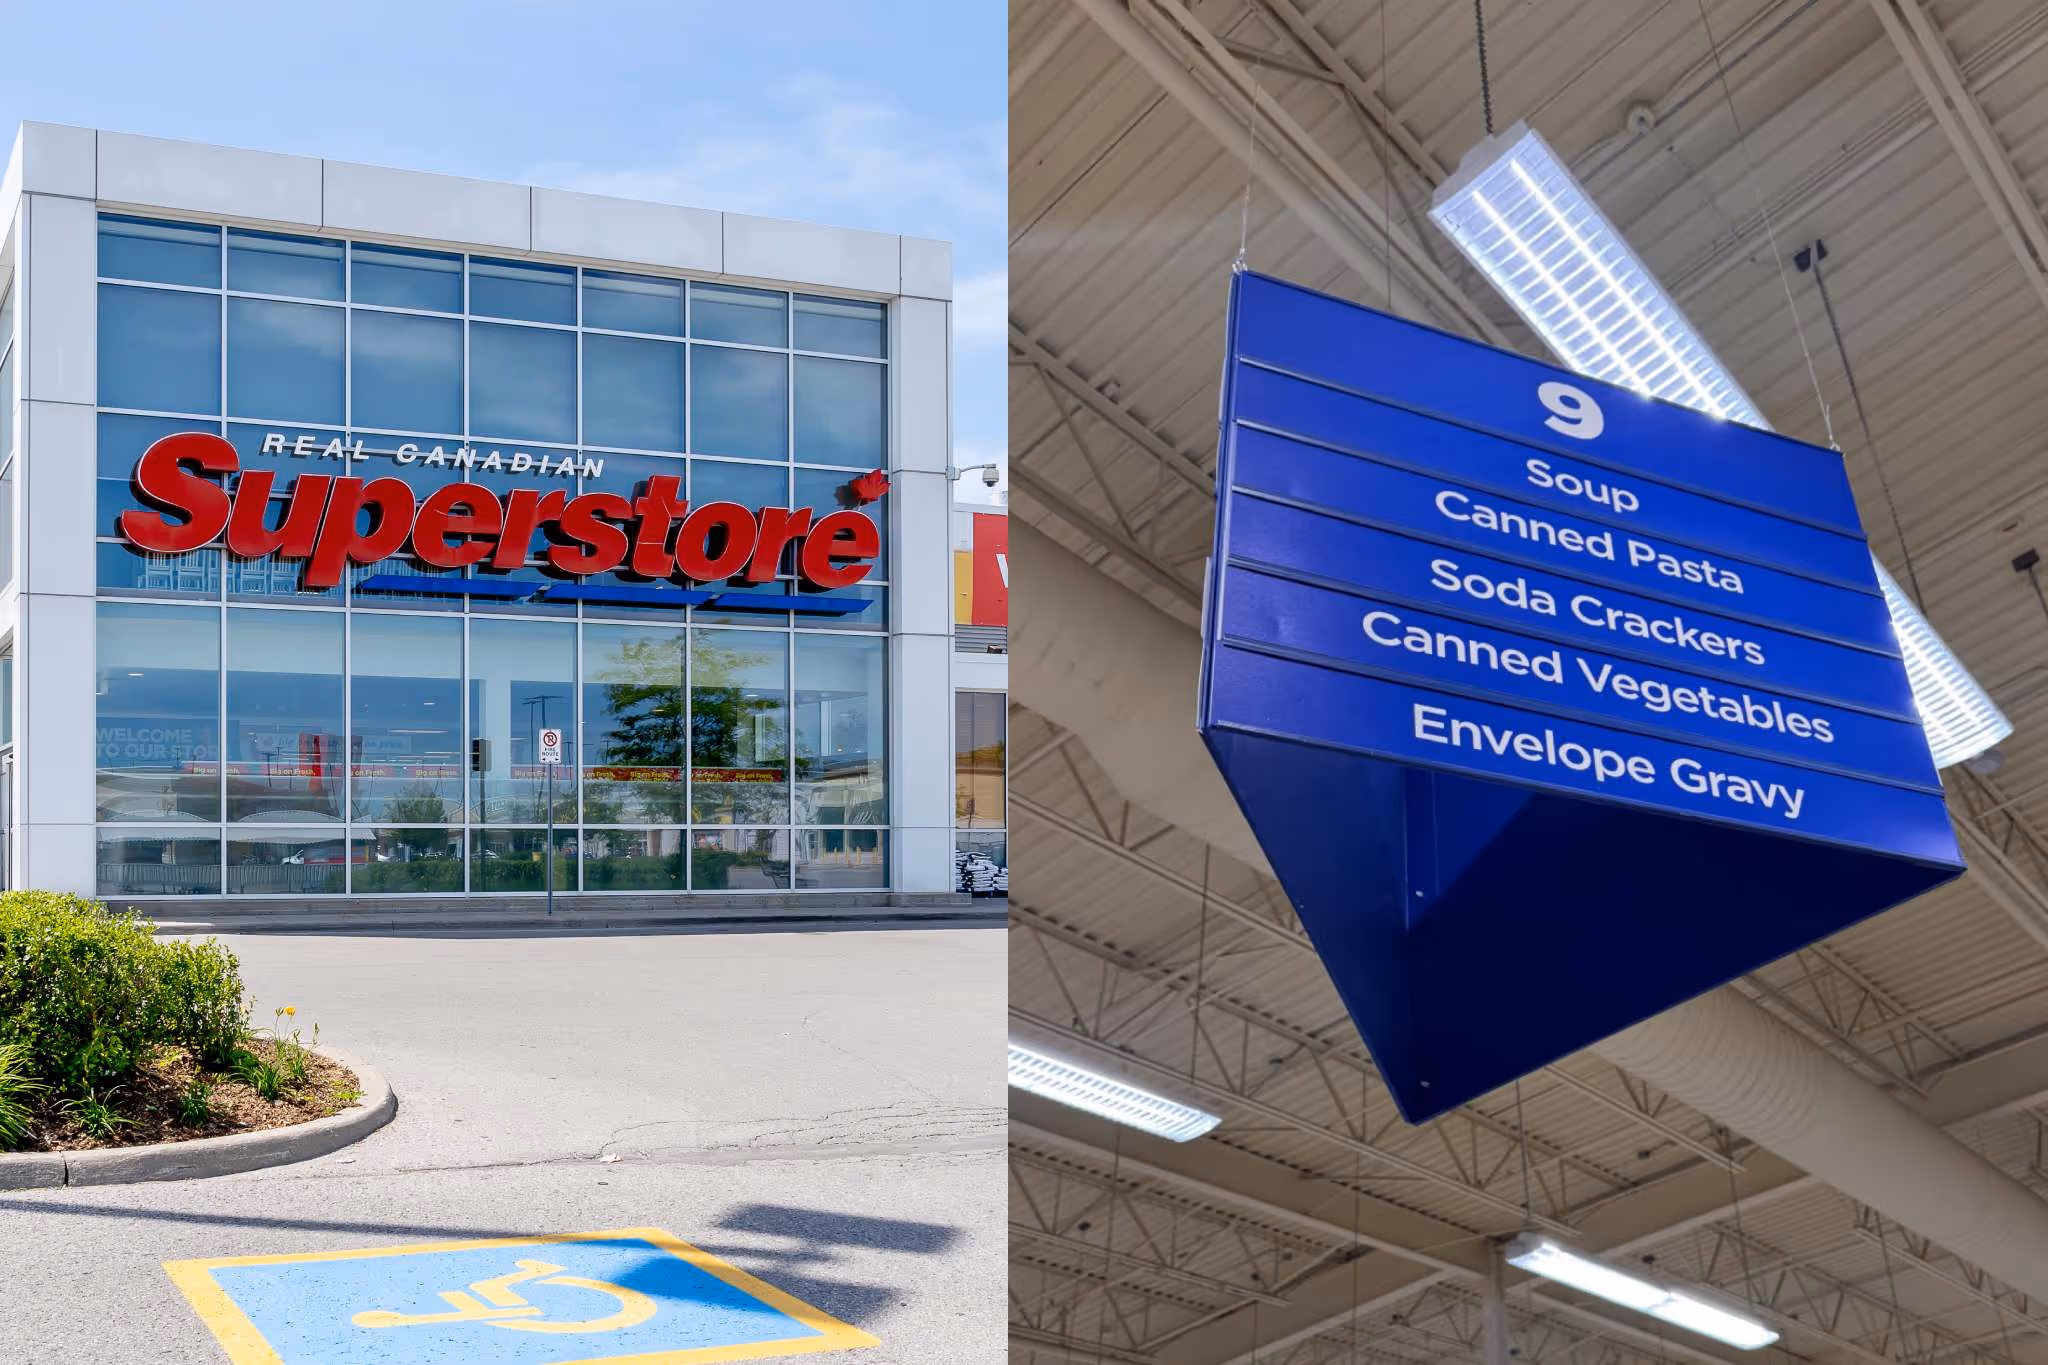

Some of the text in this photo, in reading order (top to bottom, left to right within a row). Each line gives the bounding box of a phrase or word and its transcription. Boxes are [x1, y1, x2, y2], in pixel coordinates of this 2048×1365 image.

[262, 433, 605, 478] REAL CANADIAN
[1537, 381, 1605, 440] 9
[120, 432, 882, 590] Superstore
[1526, 459, 1639, 514] Soup
[1435, 490, 1745, 595] Canned Pasta
[1431, 558, 1766, 666] Soda Crackers
[1362, 611, 1835, 744] Canned Vegetables
[96, 728, 193, 743] WELCOME
[1413, 702, 1805, 820] Envelope Gravy
